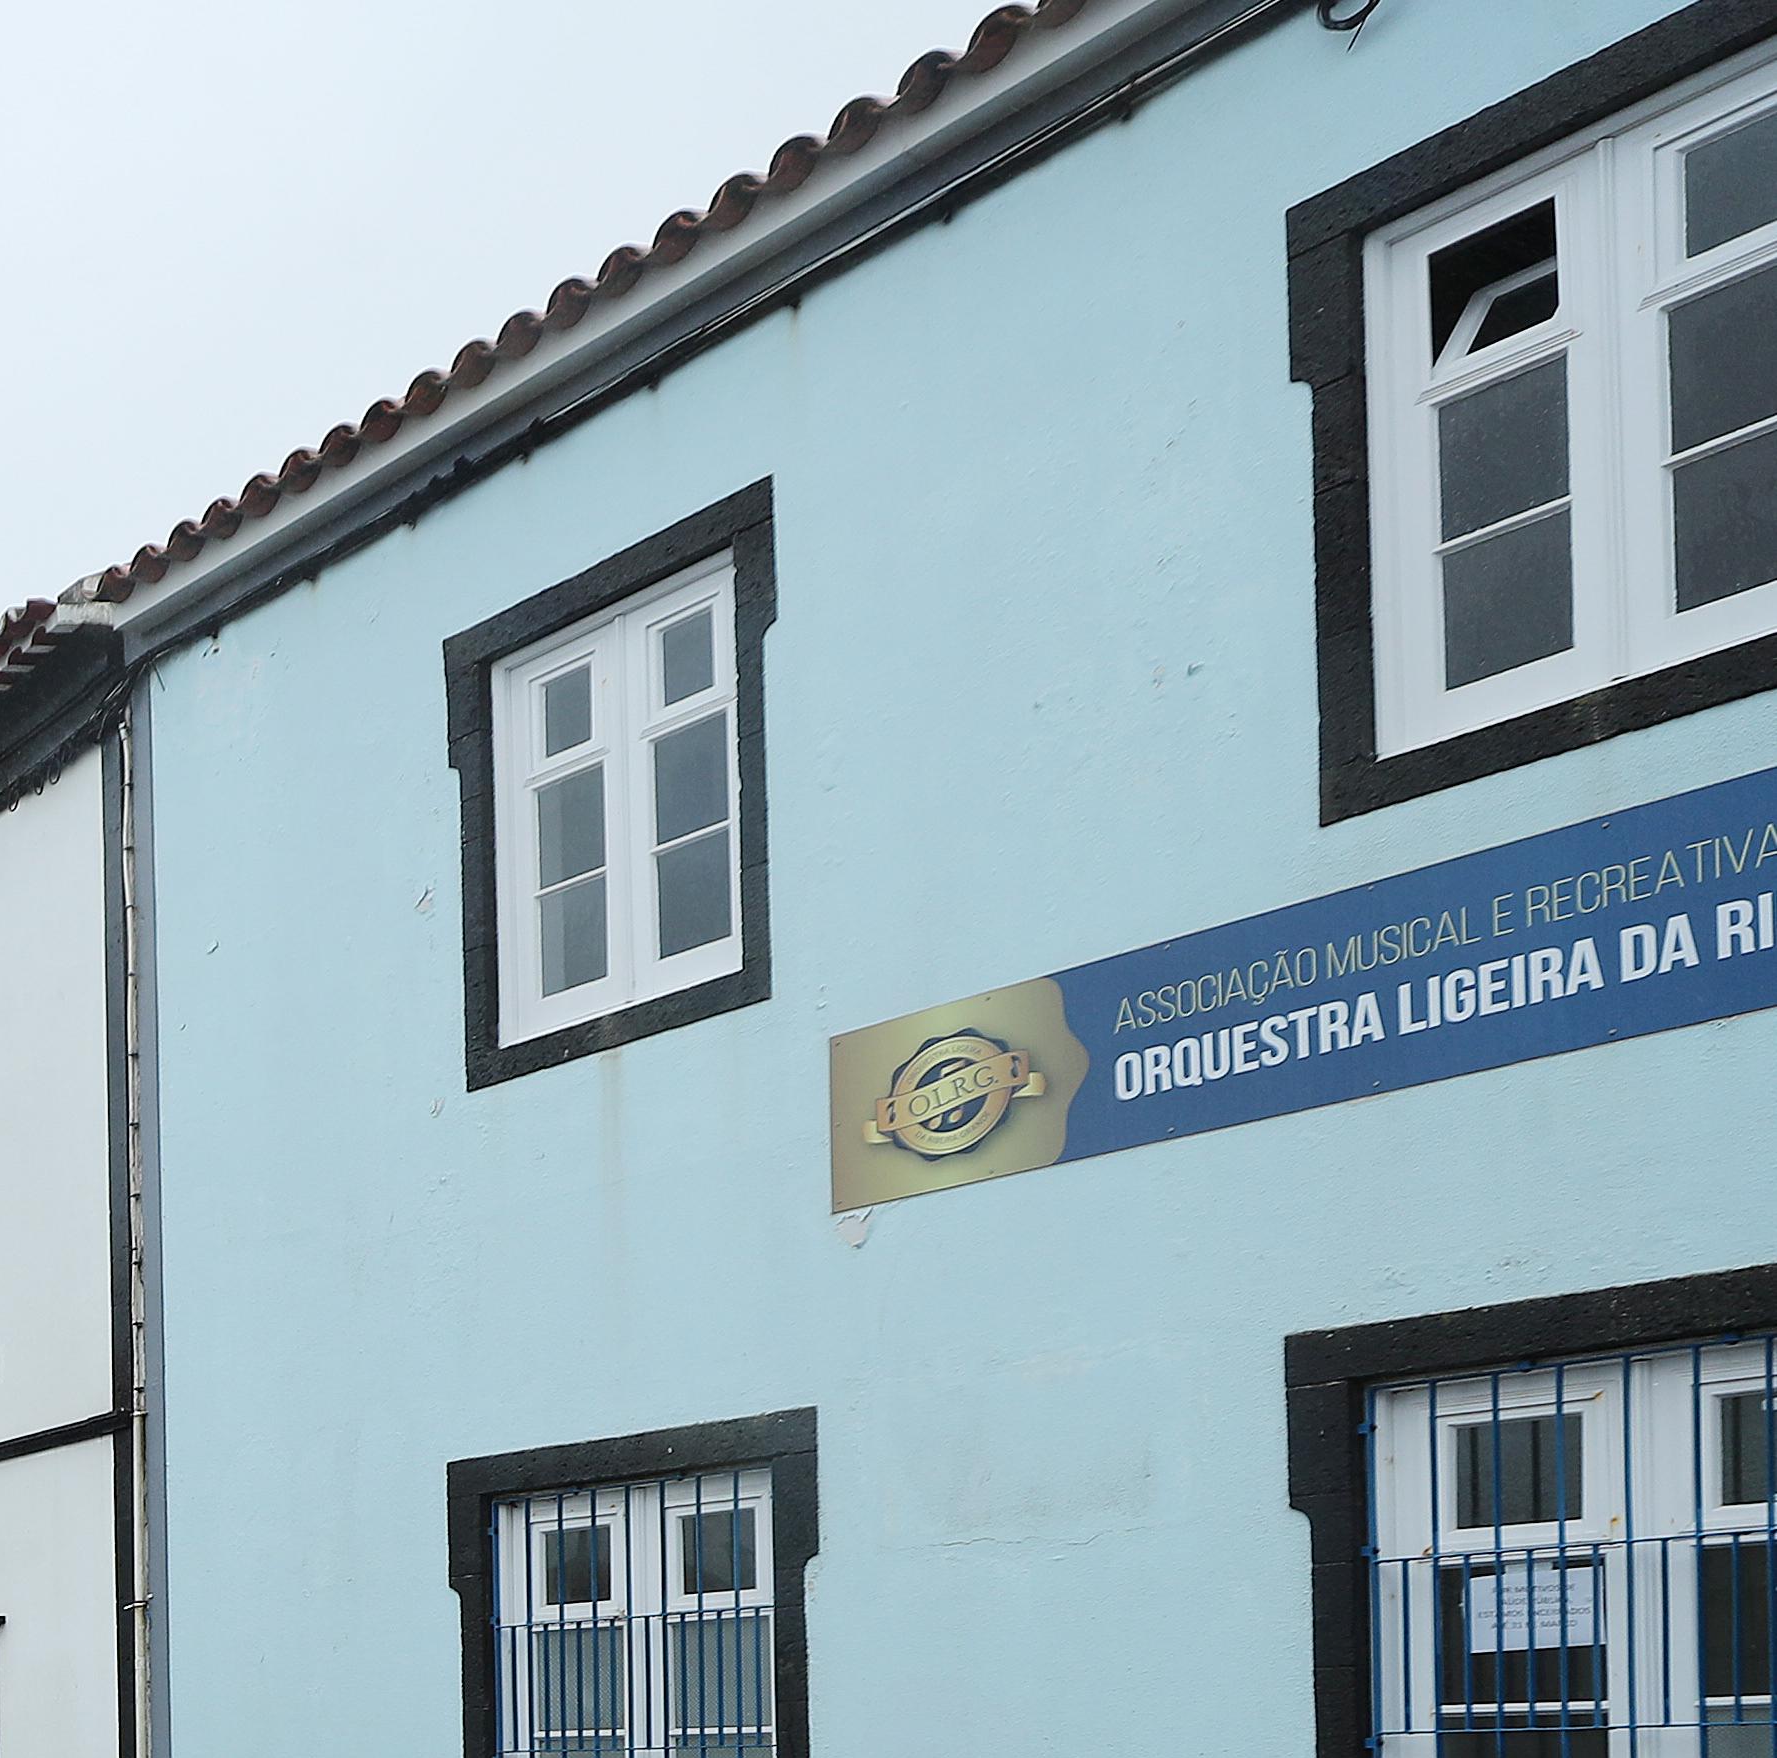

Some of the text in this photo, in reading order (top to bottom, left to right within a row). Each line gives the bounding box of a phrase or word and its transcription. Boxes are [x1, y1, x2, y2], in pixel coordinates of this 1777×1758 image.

[1114, 822, 1777, 1035] ASSOCIAÇÃO MUSICAL E RECREATIVA
[1114, 891, 1775, 1101] ORQUESTRA LIGEIRA DA RI
